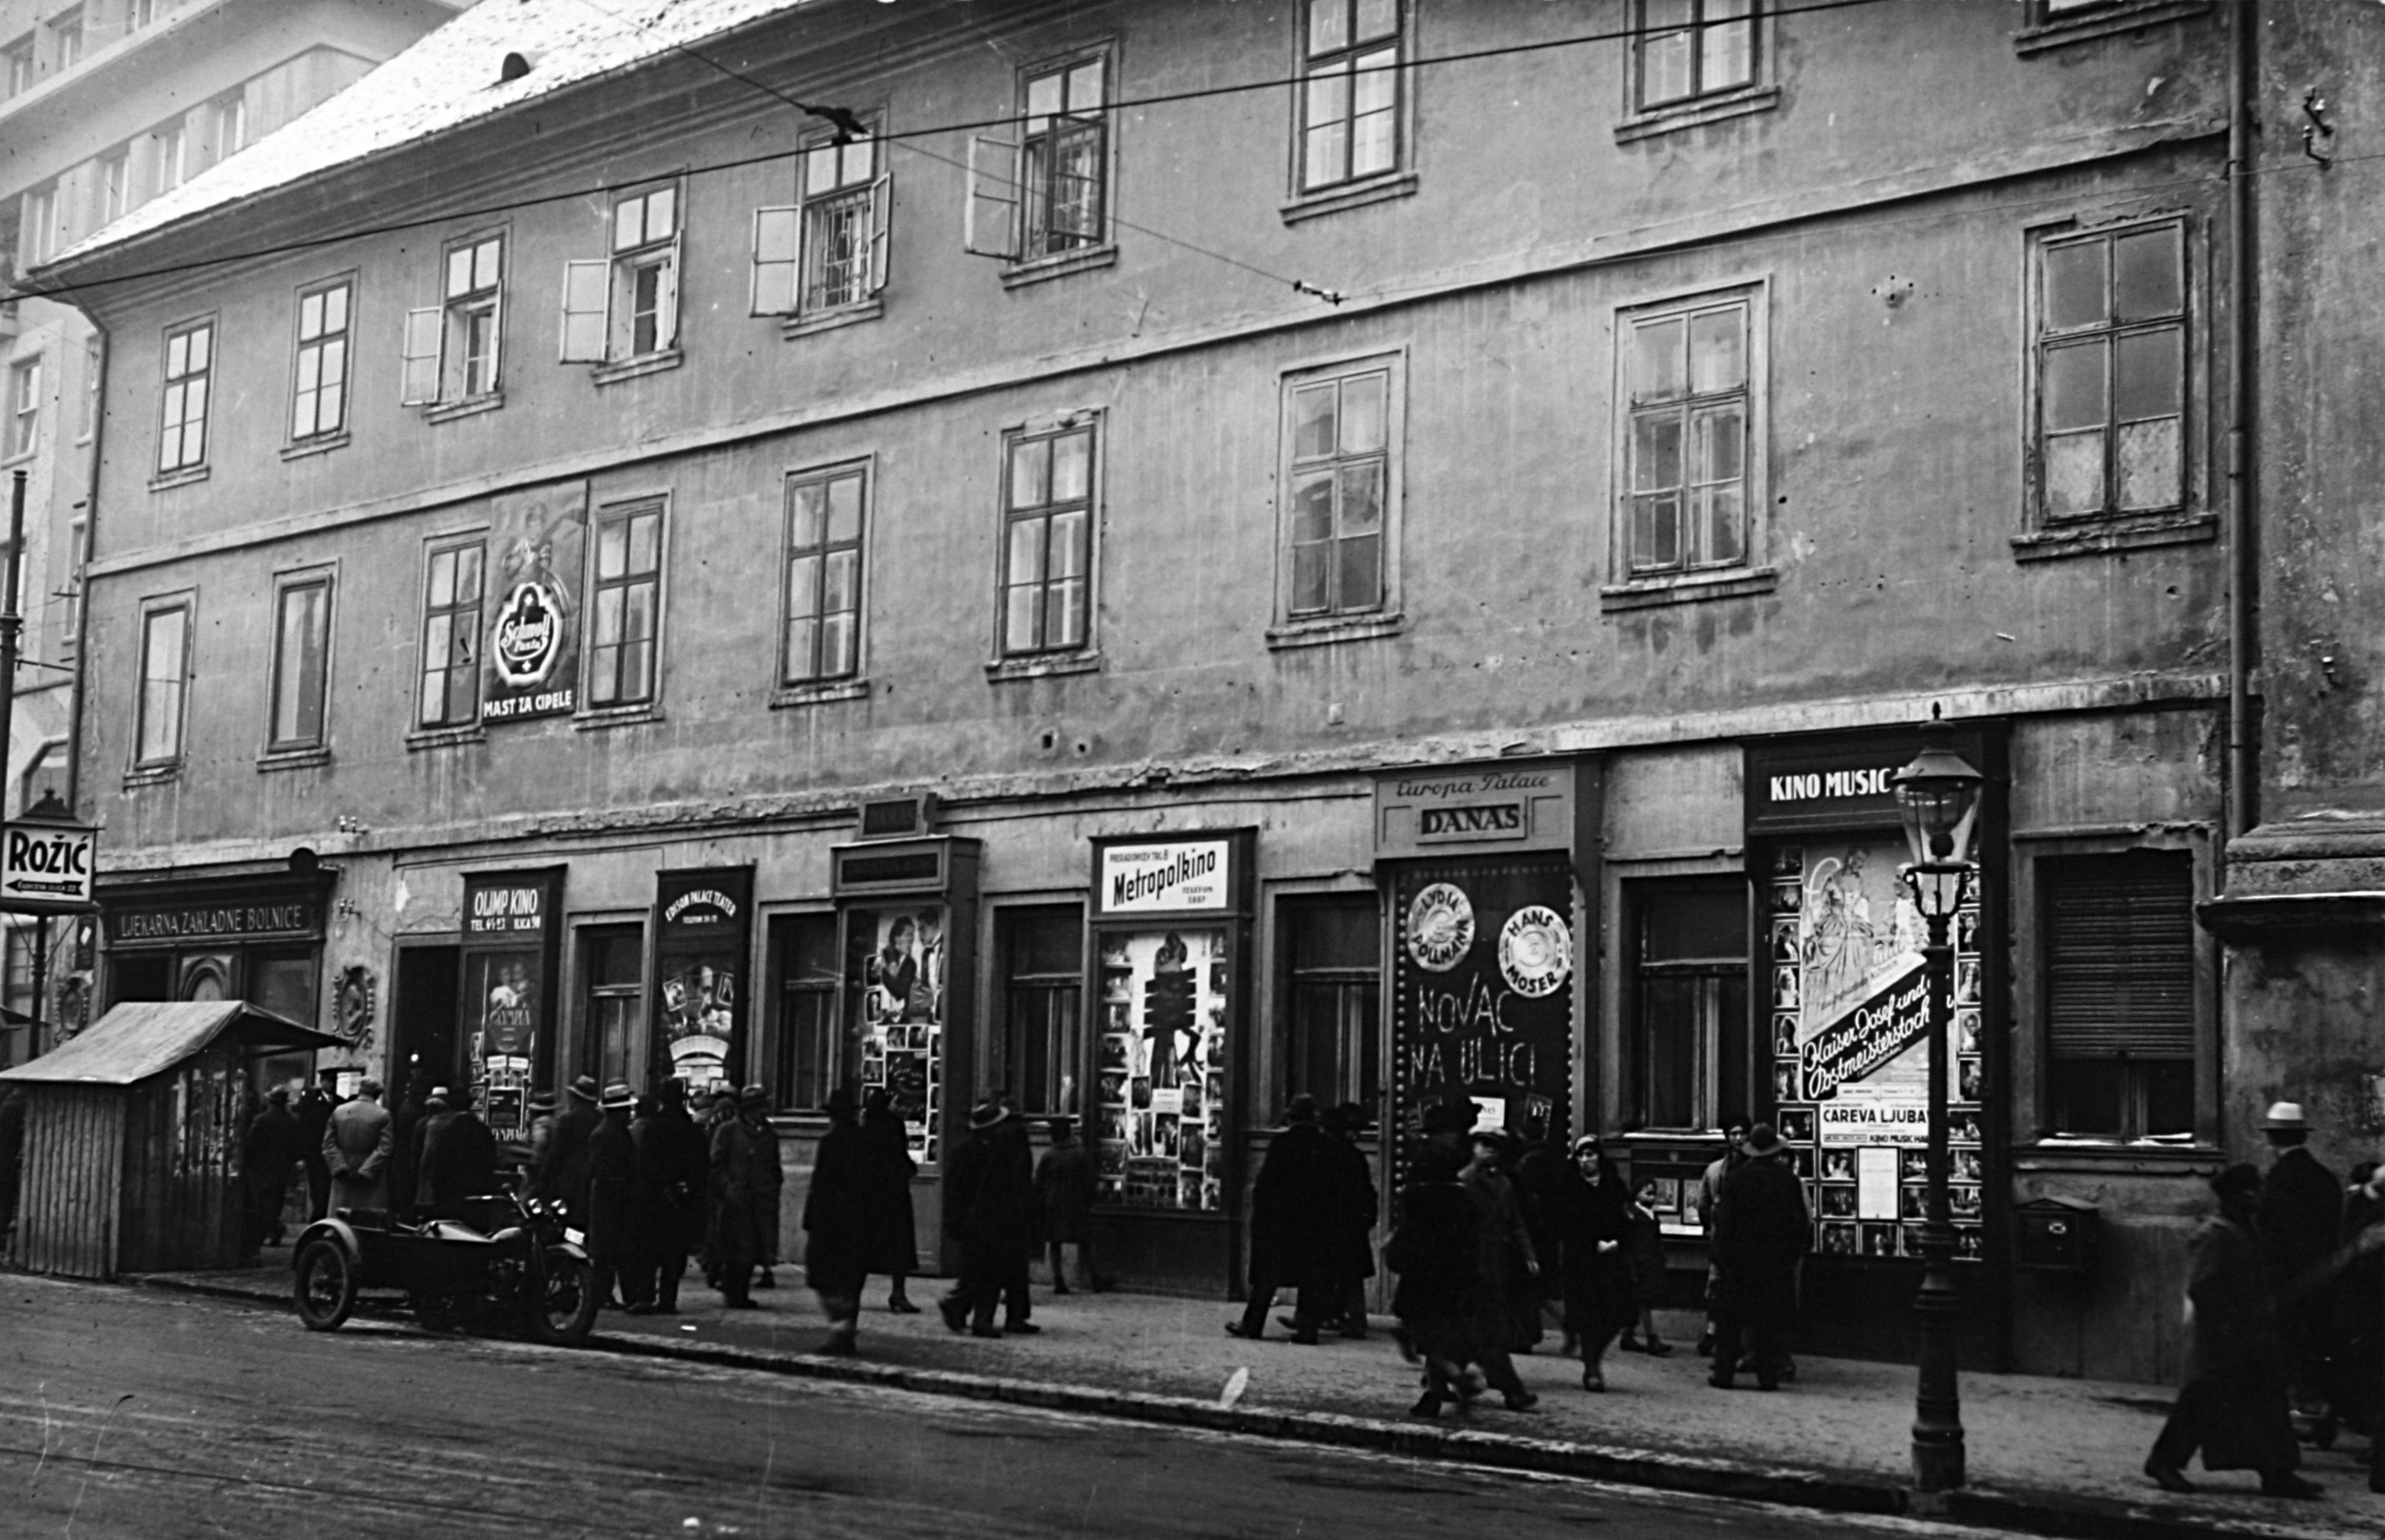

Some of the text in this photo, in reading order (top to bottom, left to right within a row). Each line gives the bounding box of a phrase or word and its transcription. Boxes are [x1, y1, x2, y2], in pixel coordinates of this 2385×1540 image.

[483, 690, 572, 717] MAST ZA CIPELE
[1397, 772, 1549, 799] Europa Palace
[1770, 768, 1892, 801] KINO MUSIC
[1422, 806, 1520, 834] DANAS
[9, 830, 89, 875] ROŽIĆ
[1113, 848, 1216, 907] Metropolkino
[1182, 885, 1214, 894] TELEFON
[474, 888, 538, 917] OLIMP KINO
[690, 889, 713, 904] PALACE
[1421, 890, 1459, 911] LYDIA
[122, 905, 302, 938] LJEKARNA ZAKLADNE BOLNICE
[1507, 910, 1554, 937] HANS
[1506, 965, 1558, 993] MOSER
[1420, 972, 1514, 1037] NOVAC
[1804, 1028, 1858, 1072] Kaiser
[1855, 994, 1896, 1039] Josef
[1896, 974, 1927, 1010] und
[1411, 1037, 1535, 1087] NA ULICI
[1823, 1109, 1876, 1123] CAREVA
[1870, 1135, 1889, 1143] KINO
